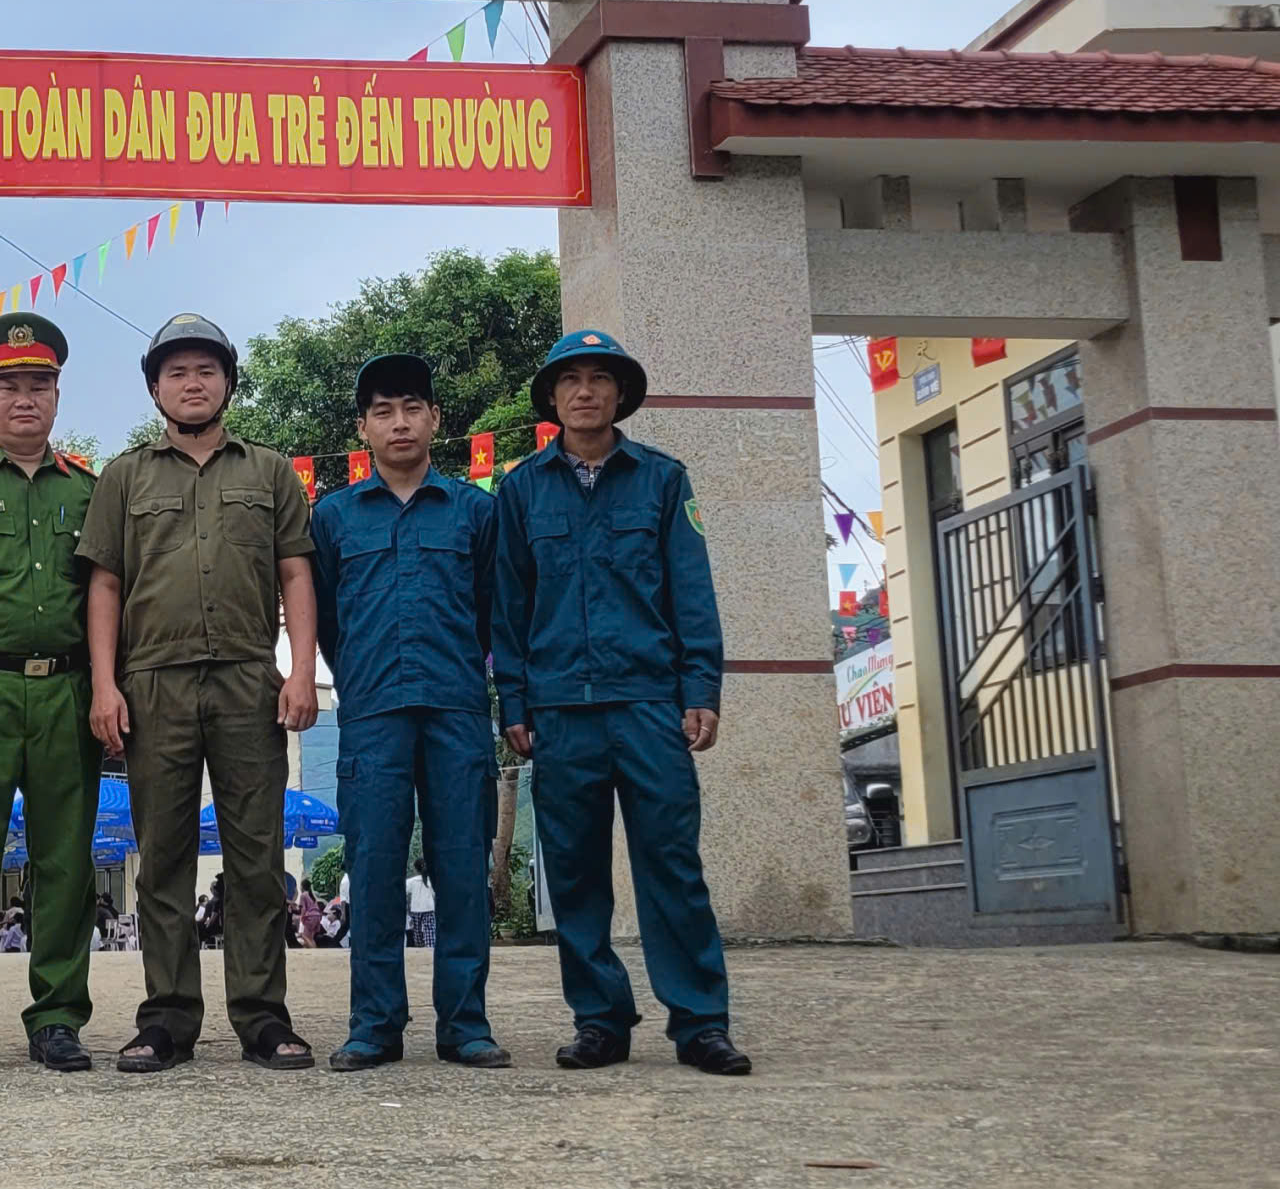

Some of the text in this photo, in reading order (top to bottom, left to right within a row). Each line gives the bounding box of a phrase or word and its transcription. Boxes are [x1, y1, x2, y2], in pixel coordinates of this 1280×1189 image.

[103, 74, 177, 163] DÂN
[186, 90, 261, 166] ĐƯA
[268, 76, 328, 166] TRẺ
[335, 72, 405, 169] ĐẾN
[413, 80, 554, 173] TRƯỜNG
